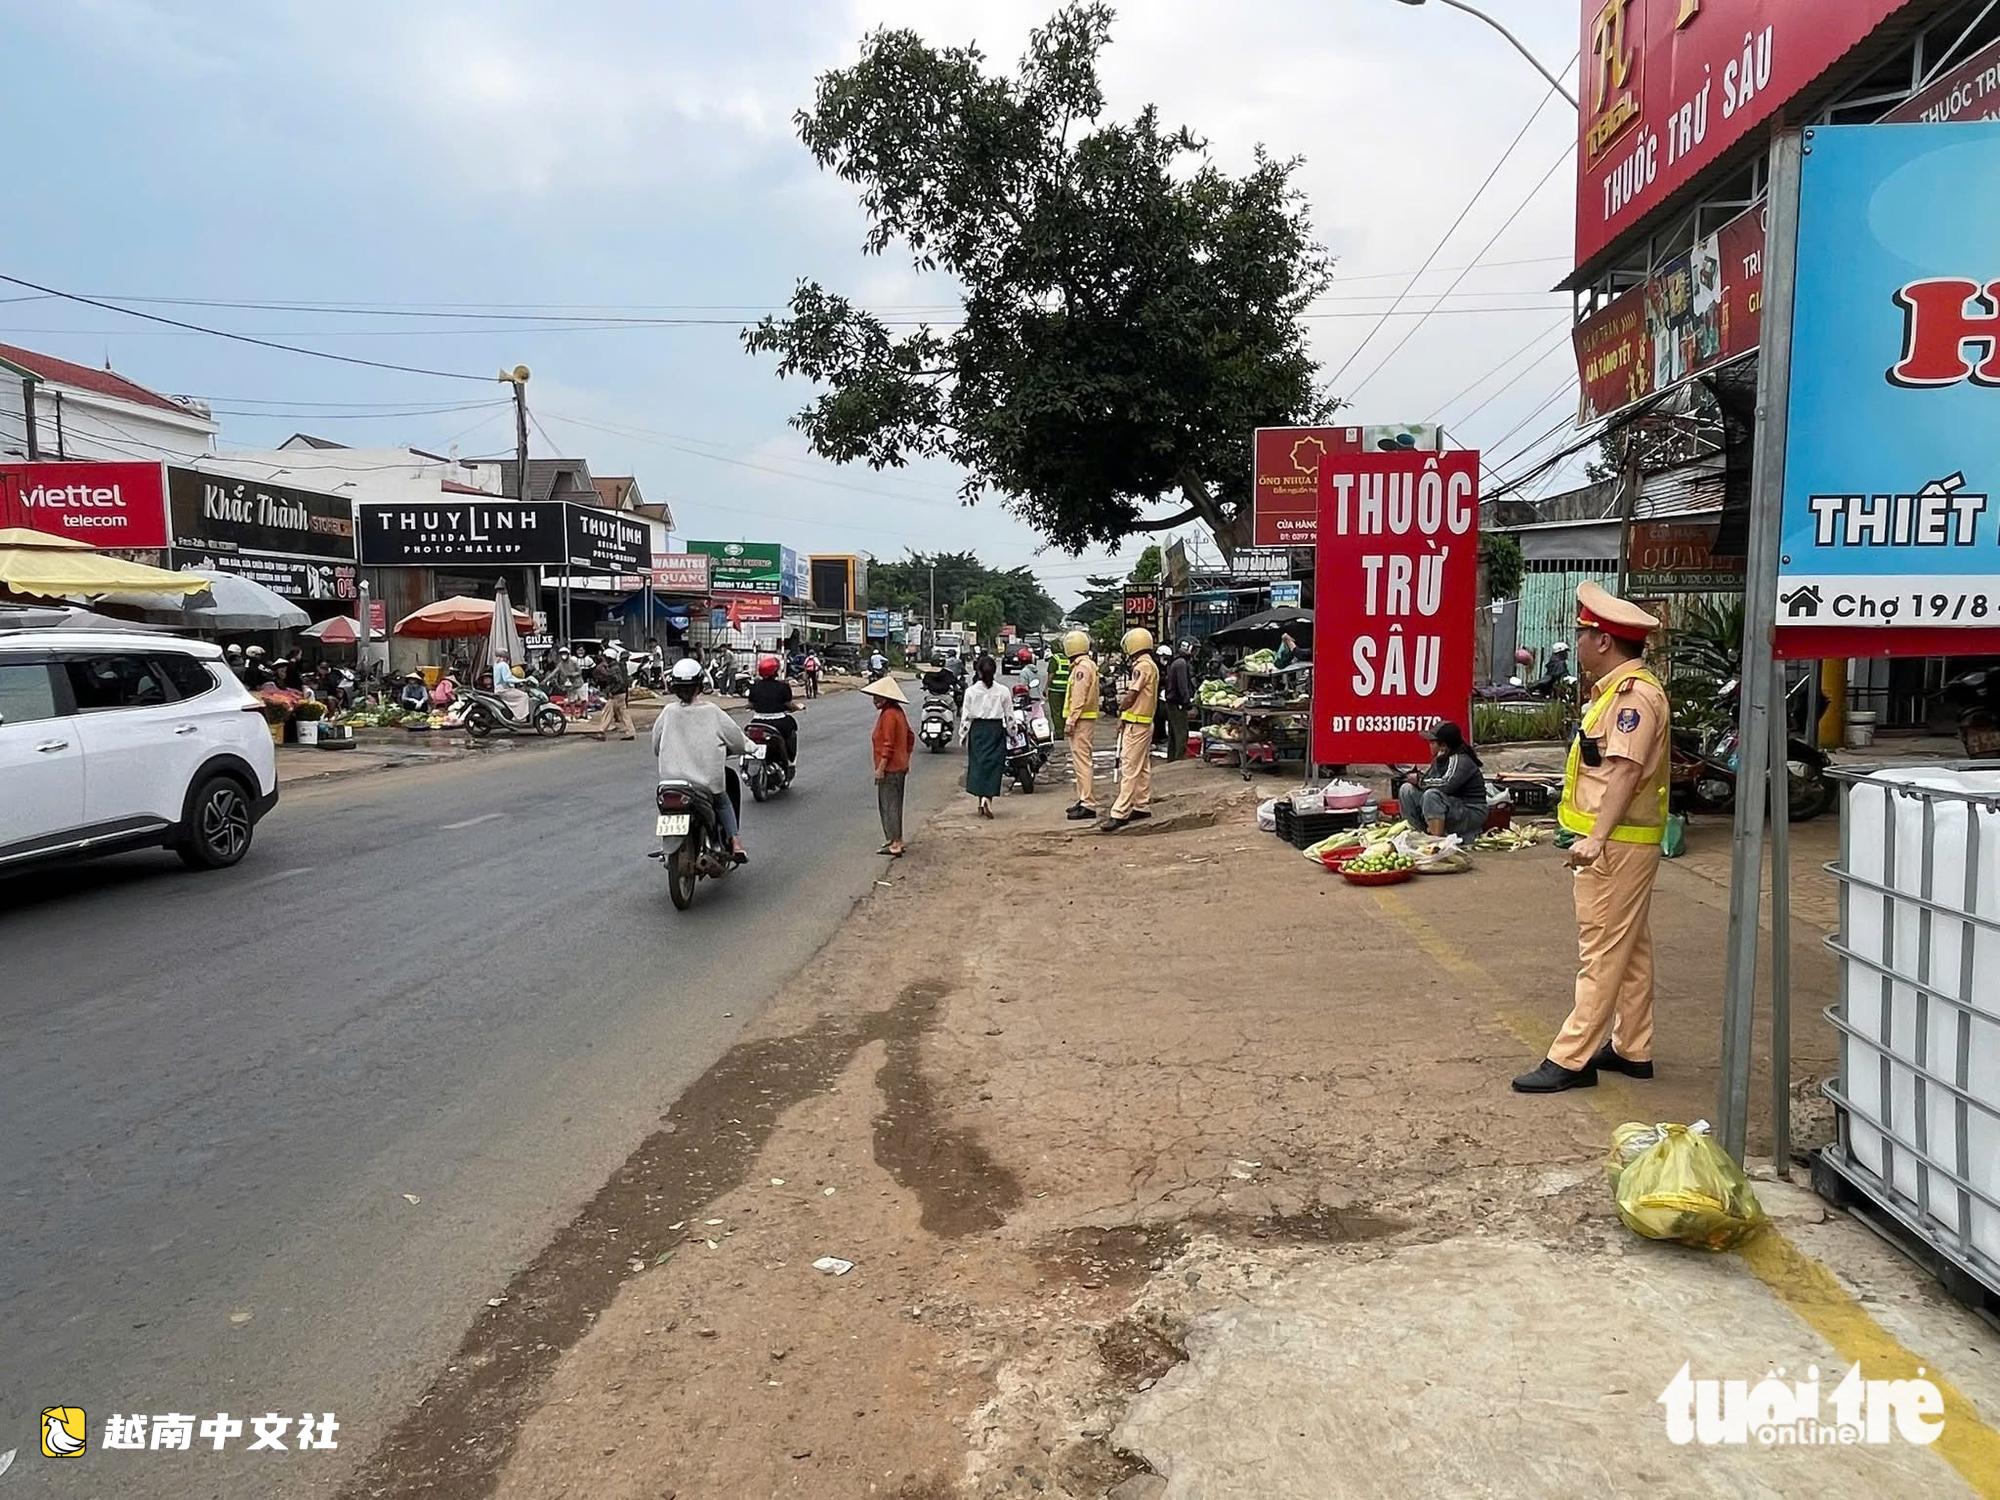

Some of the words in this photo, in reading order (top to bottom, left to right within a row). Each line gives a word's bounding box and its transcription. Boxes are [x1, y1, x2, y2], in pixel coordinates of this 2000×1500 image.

[1603, 124, 1658, 221] THUỐC
[1668, 63, 1711, 166] TRỪ
[1722, 25, 1774, 120] SÂU
[20, 484, 126, 507] viettel
[63, 514, 127, 527] telecom
[203, 484, 253, 523] Khắc
[257, 493, 309, 531] Thành
[1333, 451, 1471, 535] THUỐC
[1808, 470, 1987, 547] THIẾT
[1125, 593, 1157, 614] PHỞ
[1362, 540, 1449, 616] TRỪ
[1833, 594, 1899, 625] Chợ
[1912, 593, 1987, 621] 19/8
[1352, 624, 1441, 697] SÂU
